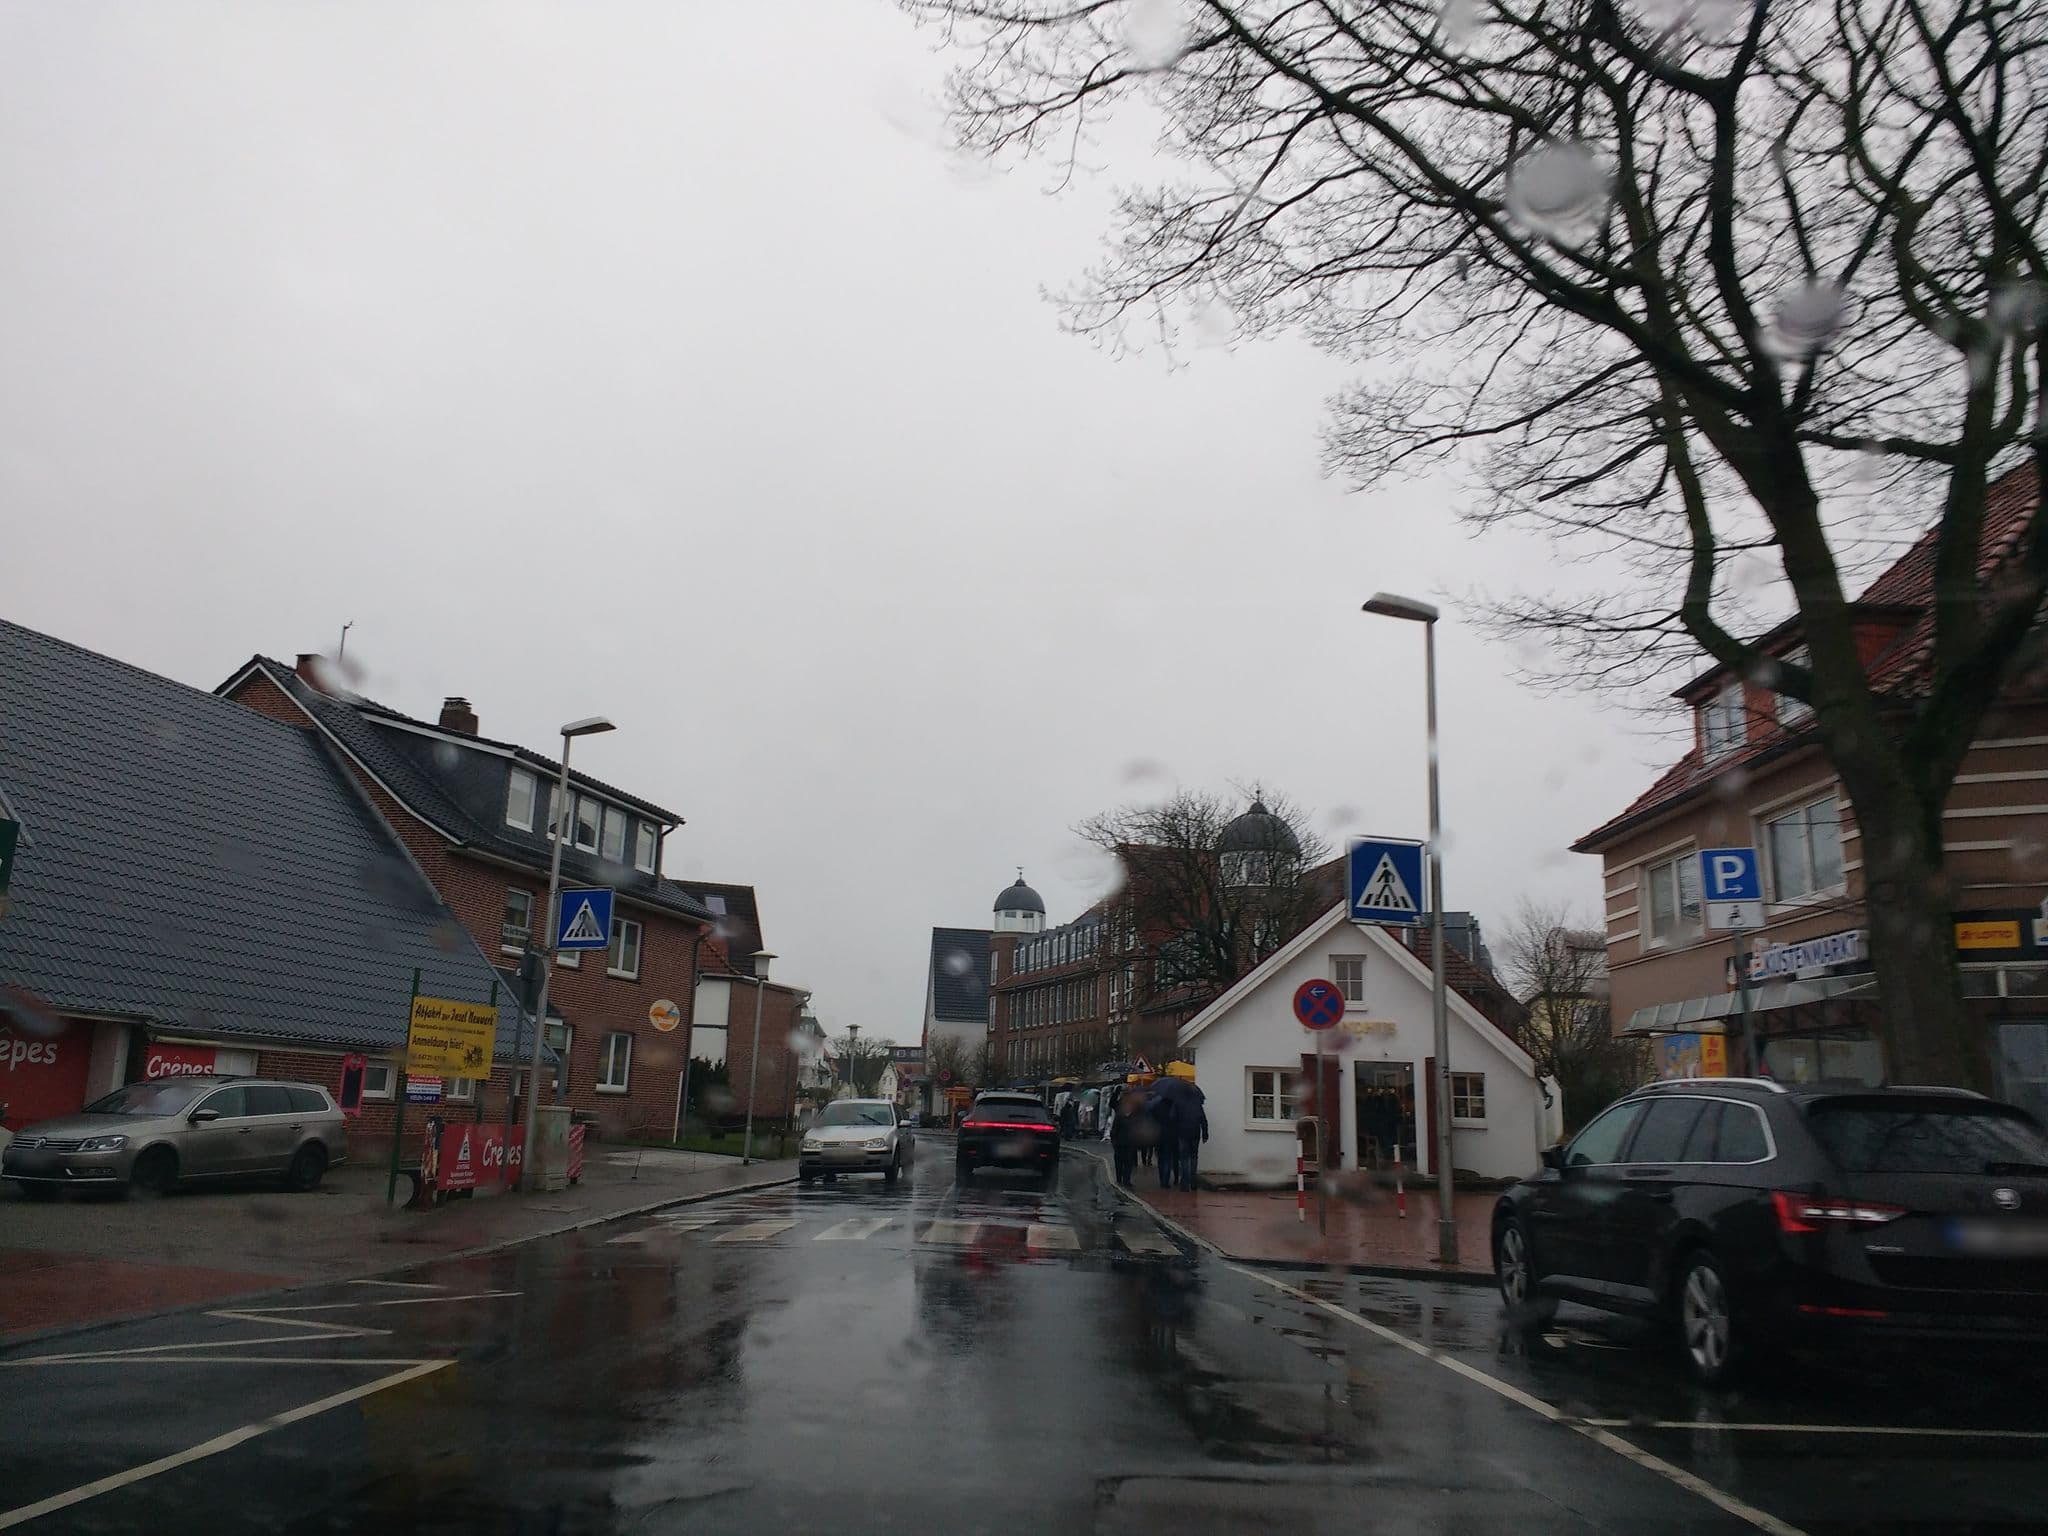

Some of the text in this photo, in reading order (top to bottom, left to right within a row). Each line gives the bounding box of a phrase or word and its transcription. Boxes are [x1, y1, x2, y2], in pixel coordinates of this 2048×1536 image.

[1711, 855, 1746, 894] P
[411, 1035, 449, 1051] Anmeldung
[482, 1136, 522, 1167] Crêes
